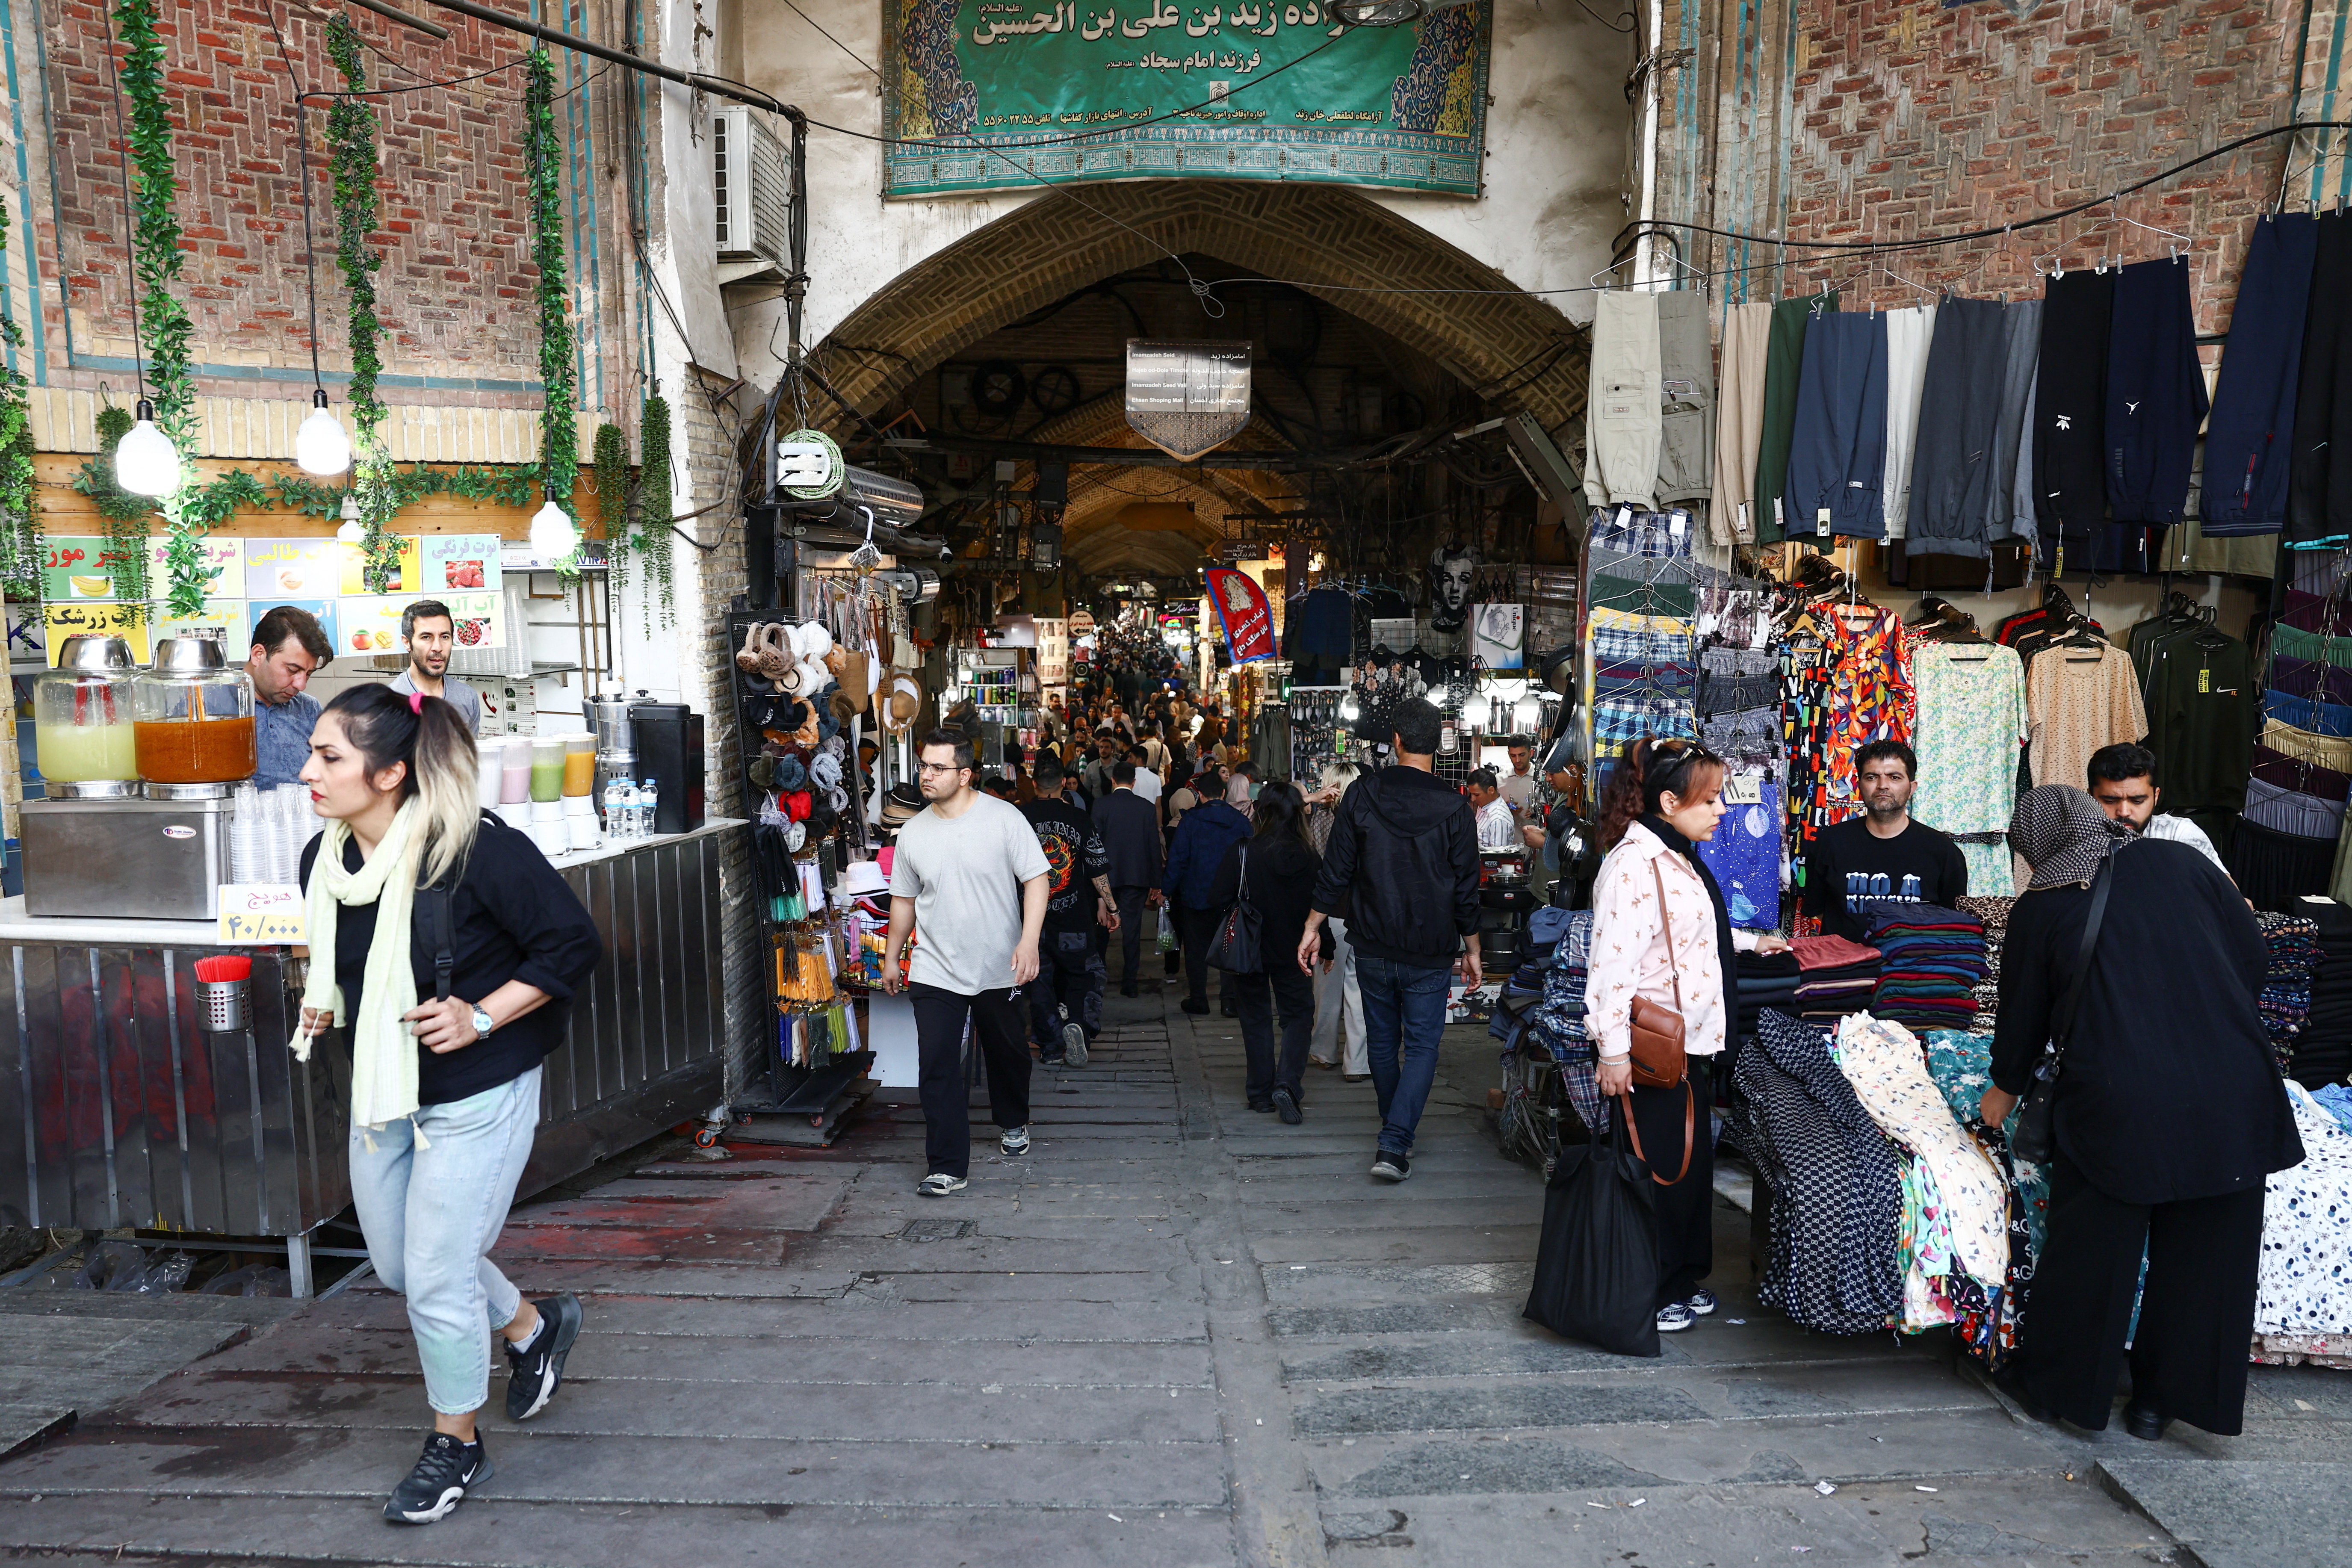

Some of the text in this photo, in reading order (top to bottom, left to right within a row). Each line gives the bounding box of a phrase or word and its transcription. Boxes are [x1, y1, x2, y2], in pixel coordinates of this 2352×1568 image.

[972, 0, 1076, 44] الحسین
[1080, 7, 1115, 41] بن
[1121, 0, 1179, 38] علی
[1185, 4, 1221, 37] بن
[1230, 0, 1277, 37] زید
[1139, 50, 1181, 73] سجاد
[1183, 50, 1215, 74] امام
[1219, 48, 1261, 73] فرزند
[1035, 113, 1051, 126] تلفن
[1059, 112, 1084, 124] کفاشها
[1084, 110, 1100, 124] بازار
[1101, 108, 1123, 121] انتهای
[1128, 106, 1153, 119] آدرس
[1213, 110, 1226, 120] امور
[1232, 109, 1249, 120] اوقاف
[1250, 109, 1266, 119] اداره
[1295, 109, 1383, 124] آرامگاه لطفعلی خان زند
[44, 544, 85, 567] موز
[248, 543, 300, 567] طالبی
[432, 537, 470, 559] فرنگی
[206, 603, 238, 626] شربت
[474, 595, 496, 615] آب
[52, 608, 107, 629] زرشک
[1233, 608, 1265, 639] کباب کسری
[1260, 623, 1268, 635] نان
[1237, 644, 1246, 656] داغ
[1085, 856, 1109, 868] GANG
[1846, 872, 1921, 896] DO A
[248, 892, 291, 909] هویج
[228, 915, 298, 940] ۴۰/۰۰۰
